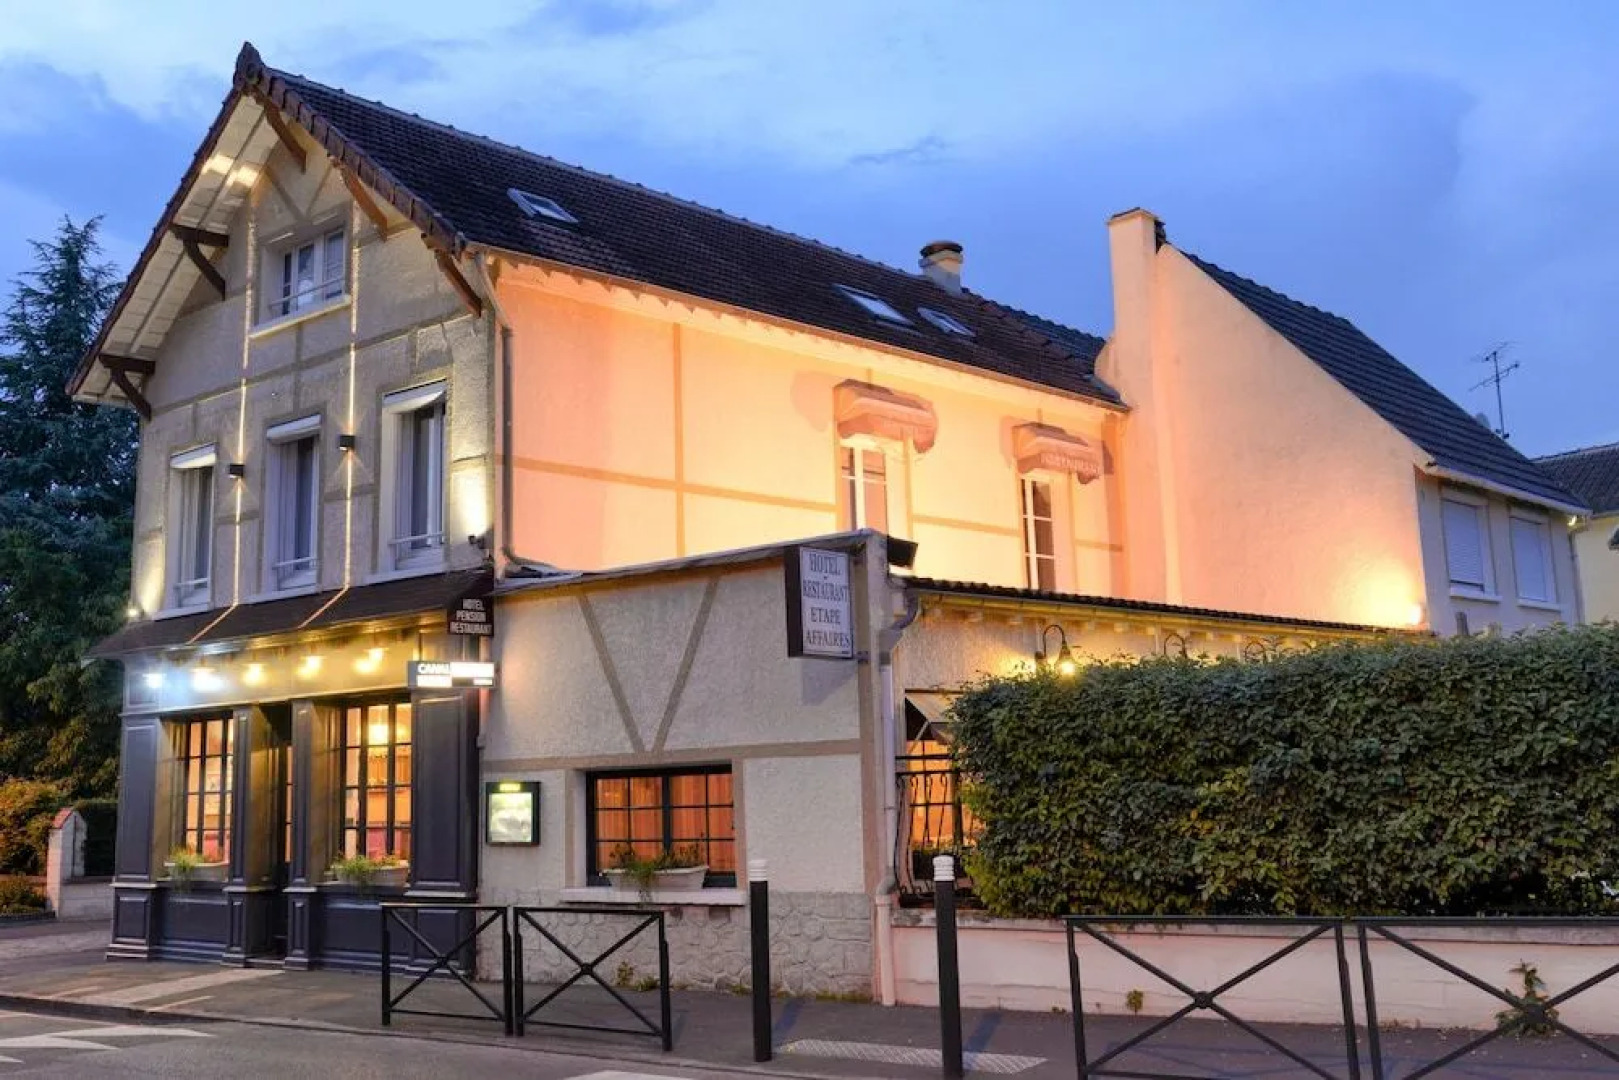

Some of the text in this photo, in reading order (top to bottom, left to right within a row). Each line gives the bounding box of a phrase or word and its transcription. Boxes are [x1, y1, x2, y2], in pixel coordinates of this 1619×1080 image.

[810, 554, 840, 575] HOTEL
[803, 579, 848, 603] RESTAURANT
[463, 599, 484, 610] HOTEL
[456, 610, 486, 622] PENSION
[810, 607, 841, 625] ETAPE
[450, 622, 492, 633] RESTAURANT
[806, 630, 850, 648] AFFAIRES
